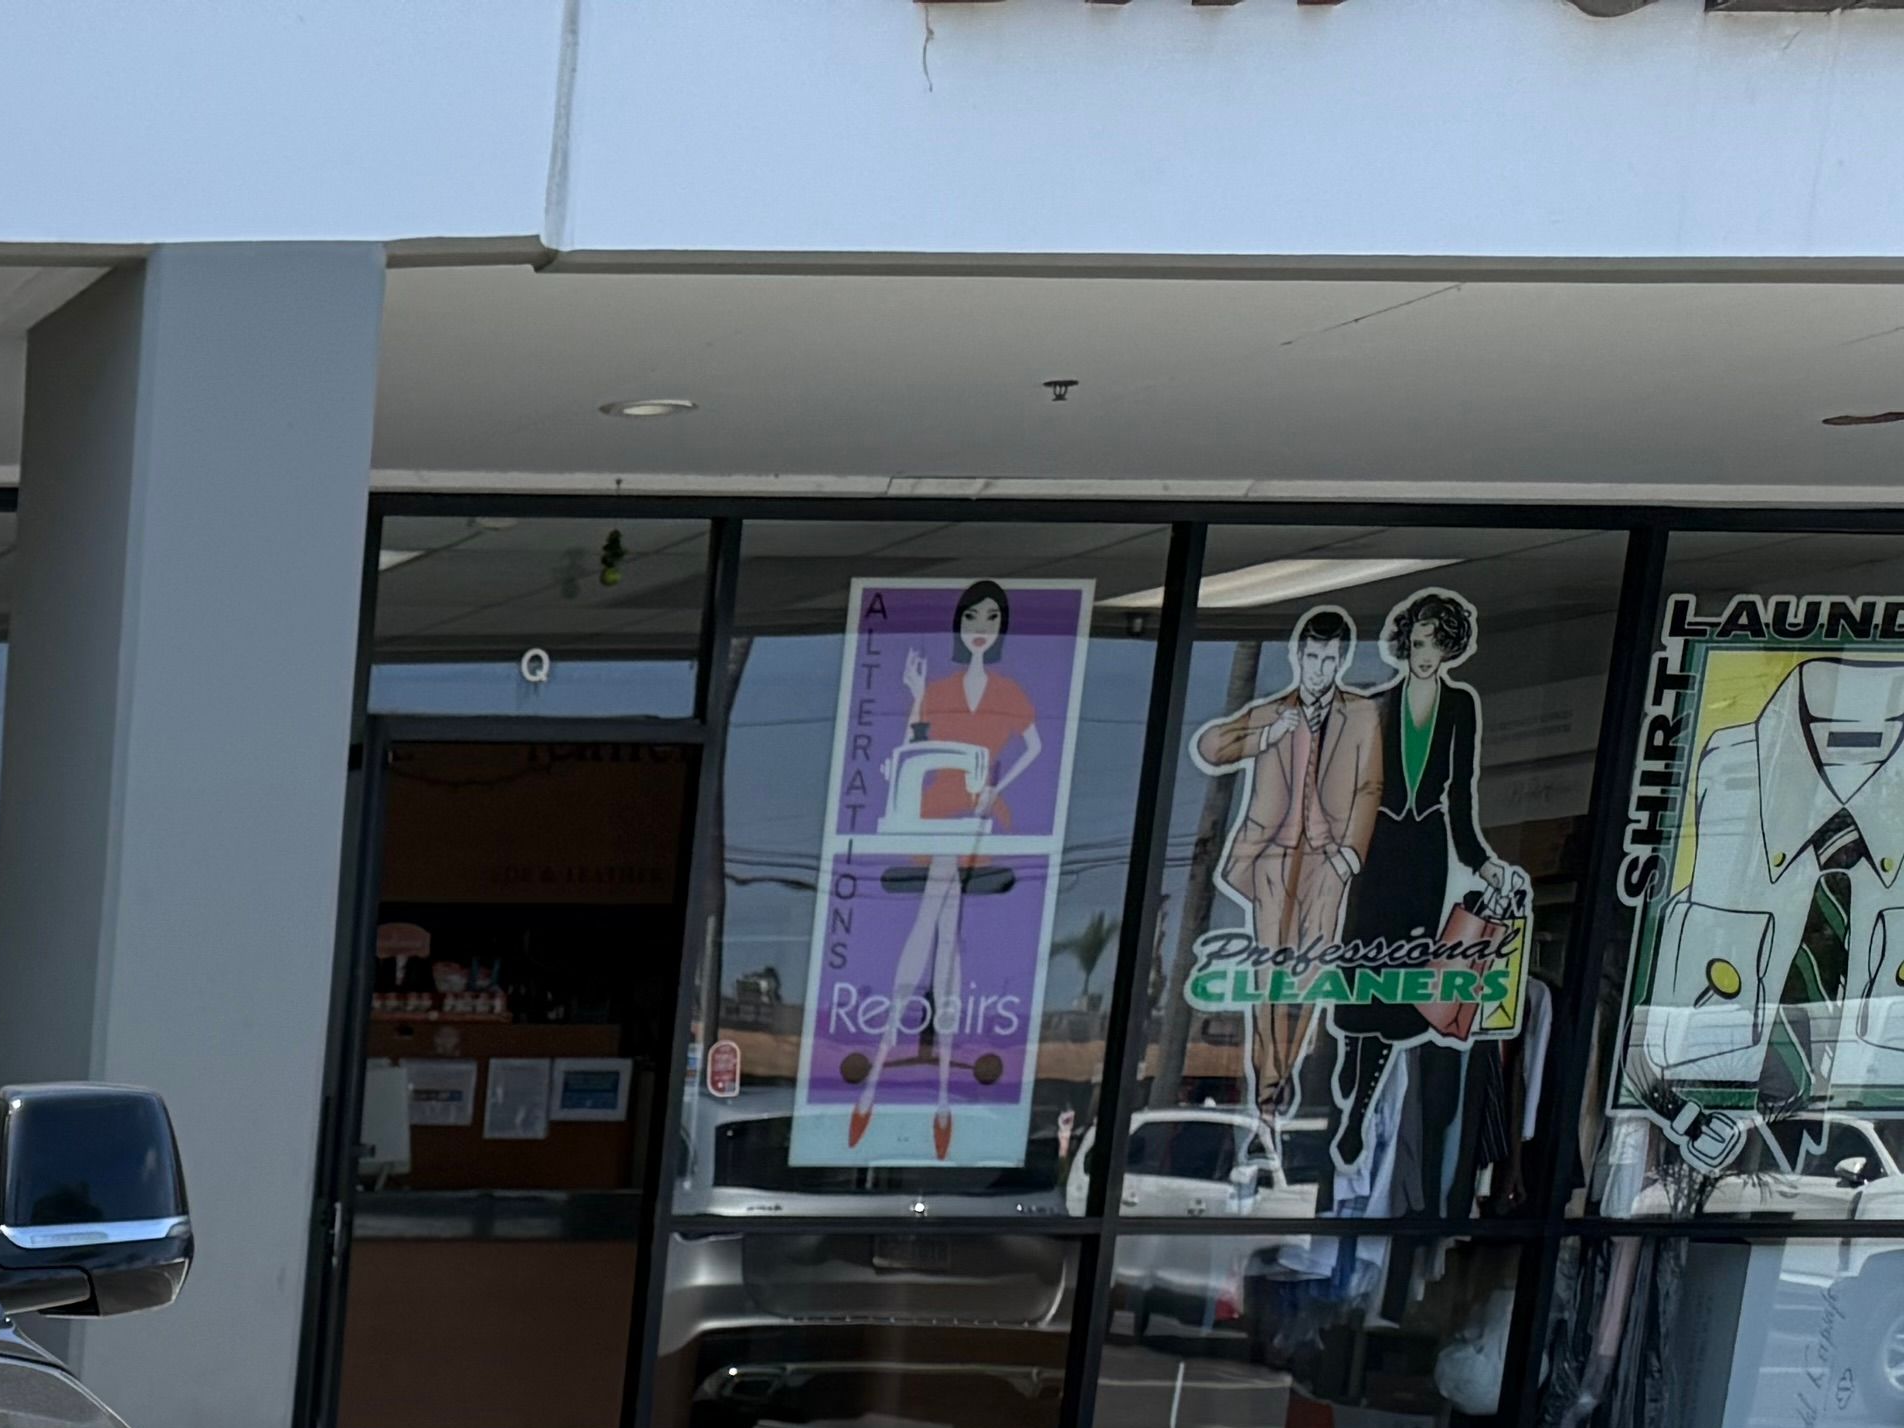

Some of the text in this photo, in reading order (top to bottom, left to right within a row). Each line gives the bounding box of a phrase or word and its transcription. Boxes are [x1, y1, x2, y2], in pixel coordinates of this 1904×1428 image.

[521, 648, 550, 682] Q
[828, 592, 888, 970] ALTERATIONS
[1623, 656, 1696, 902] SHIRT
[1197, 927, 1521, 974] Professional
[829, 980, 1021, 1047] Repairs
[1190, 968, 1511, 1004] CLEANERS
